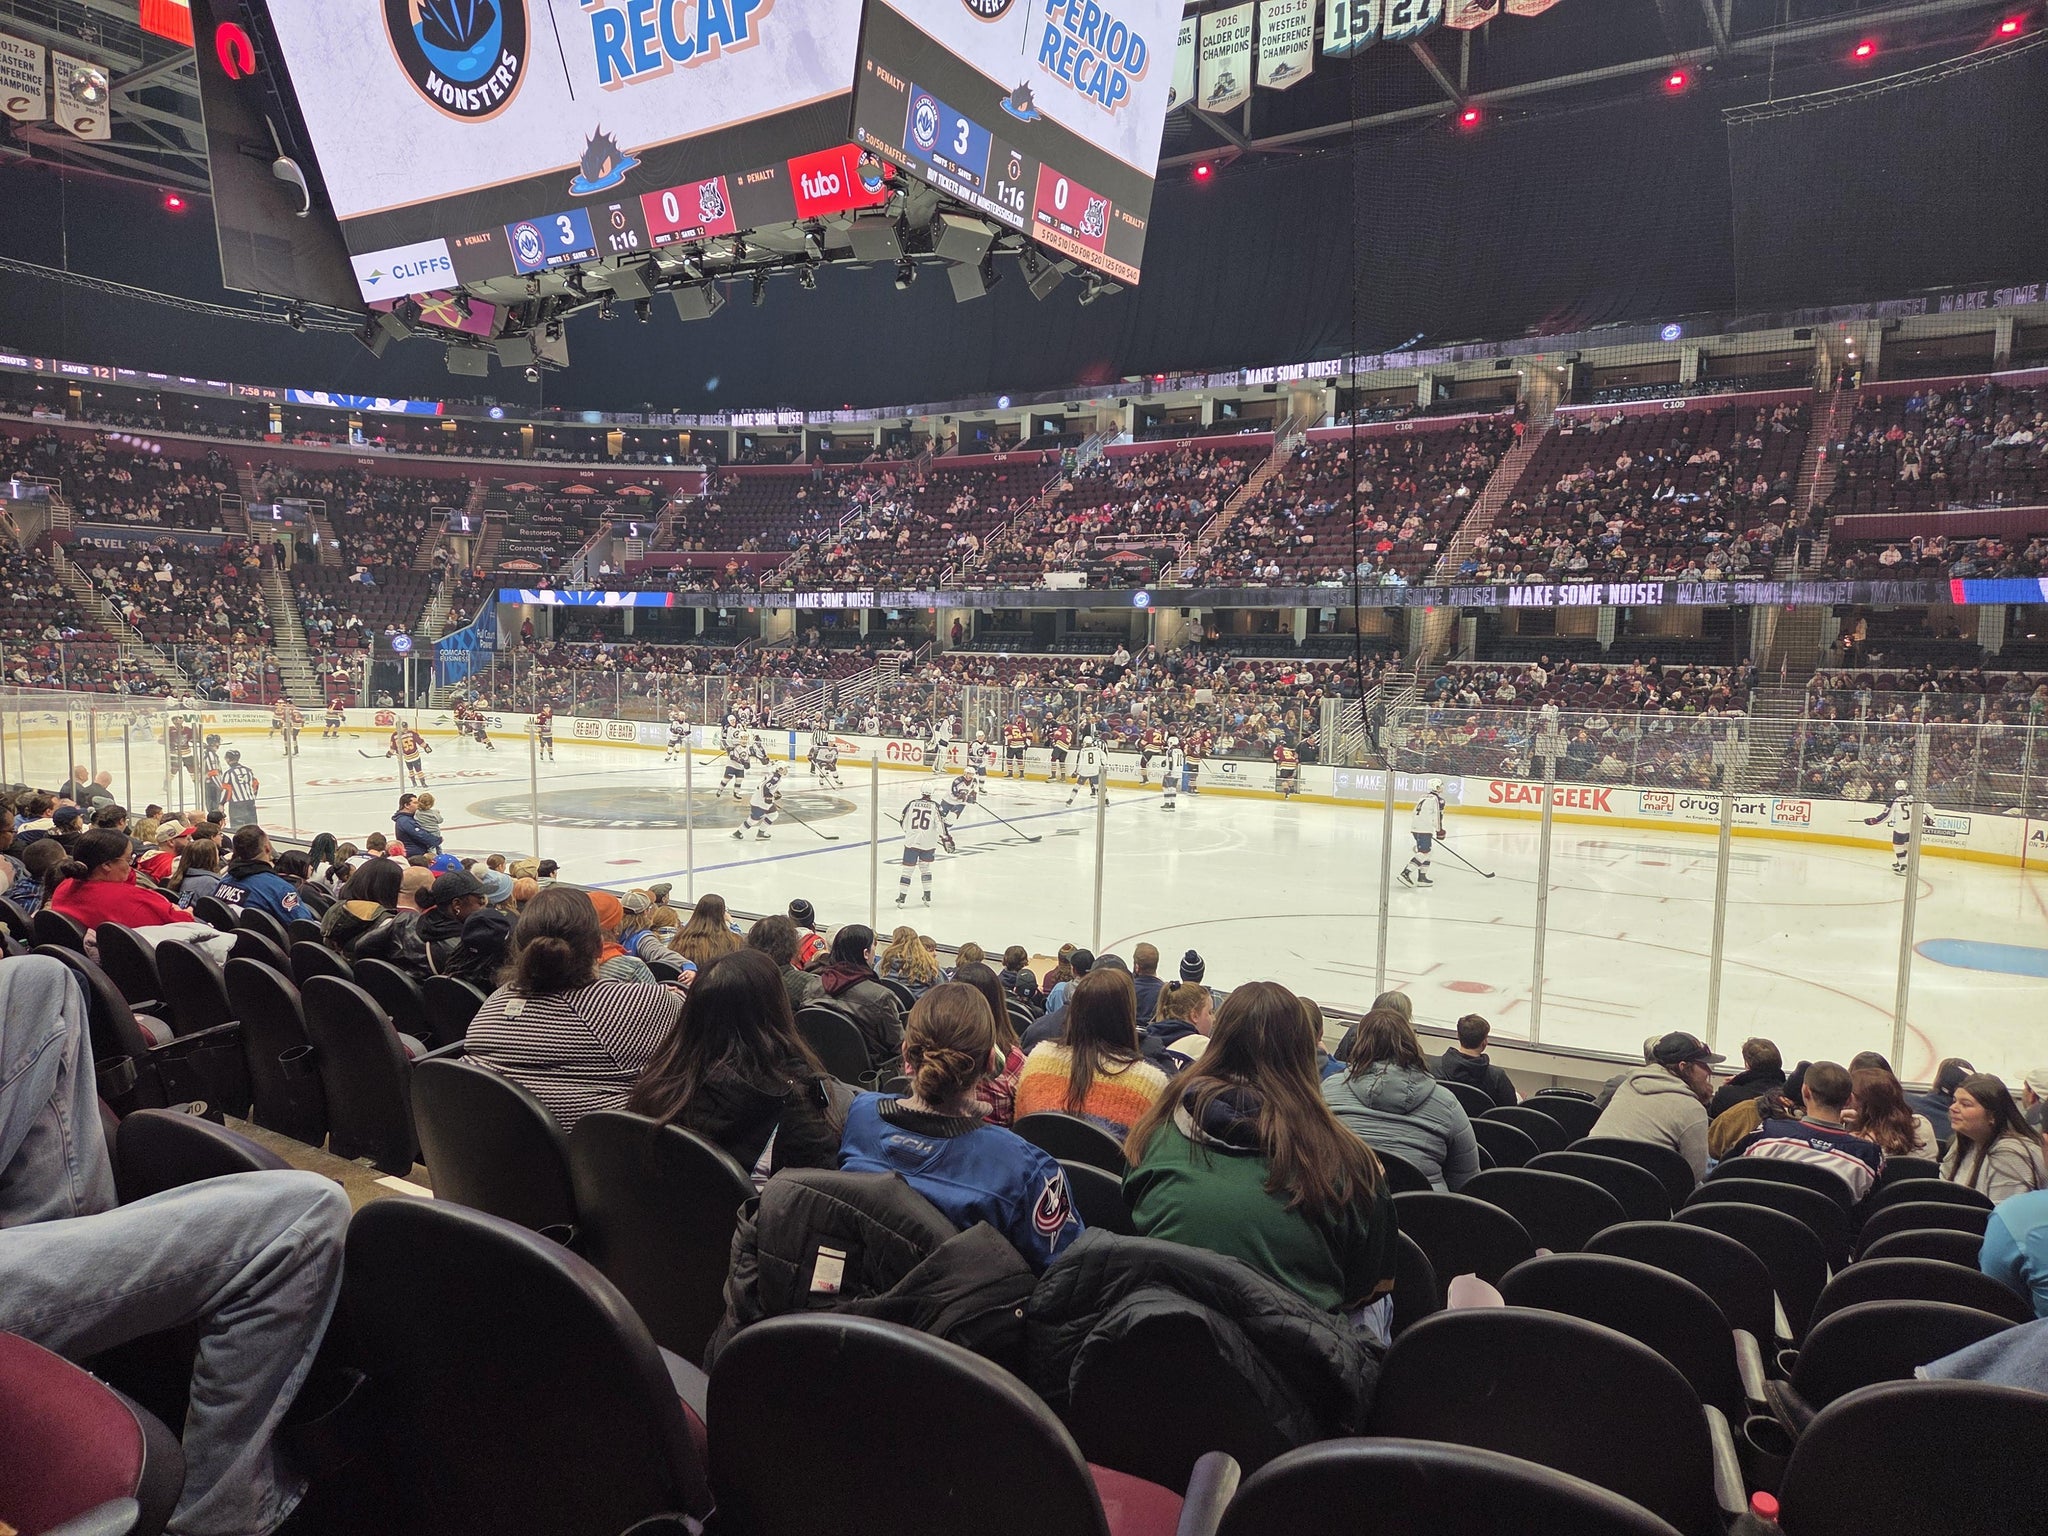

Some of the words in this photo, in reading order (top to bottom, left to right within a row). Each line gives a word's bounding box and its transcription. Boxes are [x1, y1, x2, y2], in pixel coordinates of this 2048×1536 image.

[1268, 1, 1308, 18] 2015-16
[1215, 14, 1238, 29] 2016
[1268, 14, 1306, 33] WESTERN
[1333, 1, 1370, 40] 15
[592, 0, 763, 86] RECAP
[1202, 29, 1232, 48] CALDER
[1234, 26, 1250, 39] CUP
[1261, 26, 1312, 47] CONFERENCE
[1202, 39, 1250, 61] CHAMPIONS
[1263, 40, 1309, 59] CHAMPIONS
[0, 64, 42, 86] NFERENCE
[1038, 22, 1128, 109] RECAP
[426, 48, 518, 111] MONSTERS
[876, 66, 906, 93] PENALTY
[953, 118, 970, 155] 3
[865, 132, 884, 152] 50/50
[884, 144, 907, 165] RAFFLE
[746, 168, 775, 185] PENALTY
[801, 169, 840, 200] fubo
[974, 176, 980, 186] 3
[997, 180, 1025, 212] 1:16
[1054, 178, 1069, 210] 0
[662, 191, 680, 223] 0
[556, 215, 576, 245] 3
[1053, 218, 1059, 227] 3
[1122, 213, 1145, 230] PENALTY
[464, 232, 492, 247] PENALTY
[608, 230, 638, 251] 1:16
[674, 231, 680, 240] 3
[696, 227, 705, 236] 12
[562, 253, 571, 263] 15
[589, 249, 596, 257] 3
[1046, 231, 1058, 244] FOR
[1079, 246, 1091, 259] FOR
[1115, 263, 1126, 275] FOR
[392, 255, 451, 281] CLIFFS
[1939, 290, 1987, 314] MAKE
[1992, 284, 2039, 308] SOME
[0, 355, 27, 367] SHOTS
[34, 358, 44, 370] 3
[61, 364, 89, 375] SAVES
[92, 366, 110, 379] 12
[238, 386, 260, 397] 7:58
[262, 390, 276, 399] PM
[1246, 367, 1275, 385] MAKE
[1276, 363, 1305, 382] SOME
[1307, 358, 1342, 377] NOISE!
[1662, 401, 1669, 409] C
[1670, 399, 1686, 408] 109
[731, 413, 754, 427] MAKE
[755, 412, 776, 426] SOME
[778, 411, 803, 425] NOISE!
[461, 516, 470, 531] R
[532, 514, 564, 523] Cleaning.
[519, 528, 562, 537] Restoration.
[509, 543, 556, 553] Construction.
[795, 592, 819, 608] MAKE
[821, 592, 844, 608] SOME
[846, 591, 874, 607] NOISE!
[1361, 587, 1400, 606] MAKE
[1405, 586, 1443, 606] SOME
[1450, 585, 1497, 606] NOISE!
[1508, 584, 1554, 606] MAKE
[1558, 583, 1603, 606] SOME
[1609, 582, 1664, 605] NOISE!
[1677, 582, 1728, 605] MAKE
[1791, 582, 1854, 604] NOISE!
[439, 648, 470, 657] COMCAST
[1355, 774, 1382, 790] MAKE
[1382, 776, 1411, 792] SME
[1488, 780, 1613, 813] SEATGEEK
[1642, 790, 1669, 804] drug
[1644, 801, 1673, 812] mart
[1679, 796, 1719, 814] drug
[1774, 801, 1805, 815] drug
[1777, 810, 1810, 823] mart
[911, 808, 932, 831] 26
[1937, 817, 1968, 830] GENIUS
[215, 883, 246, 903] HYMES
[1810, 1137, 1833, 1148] CCM
